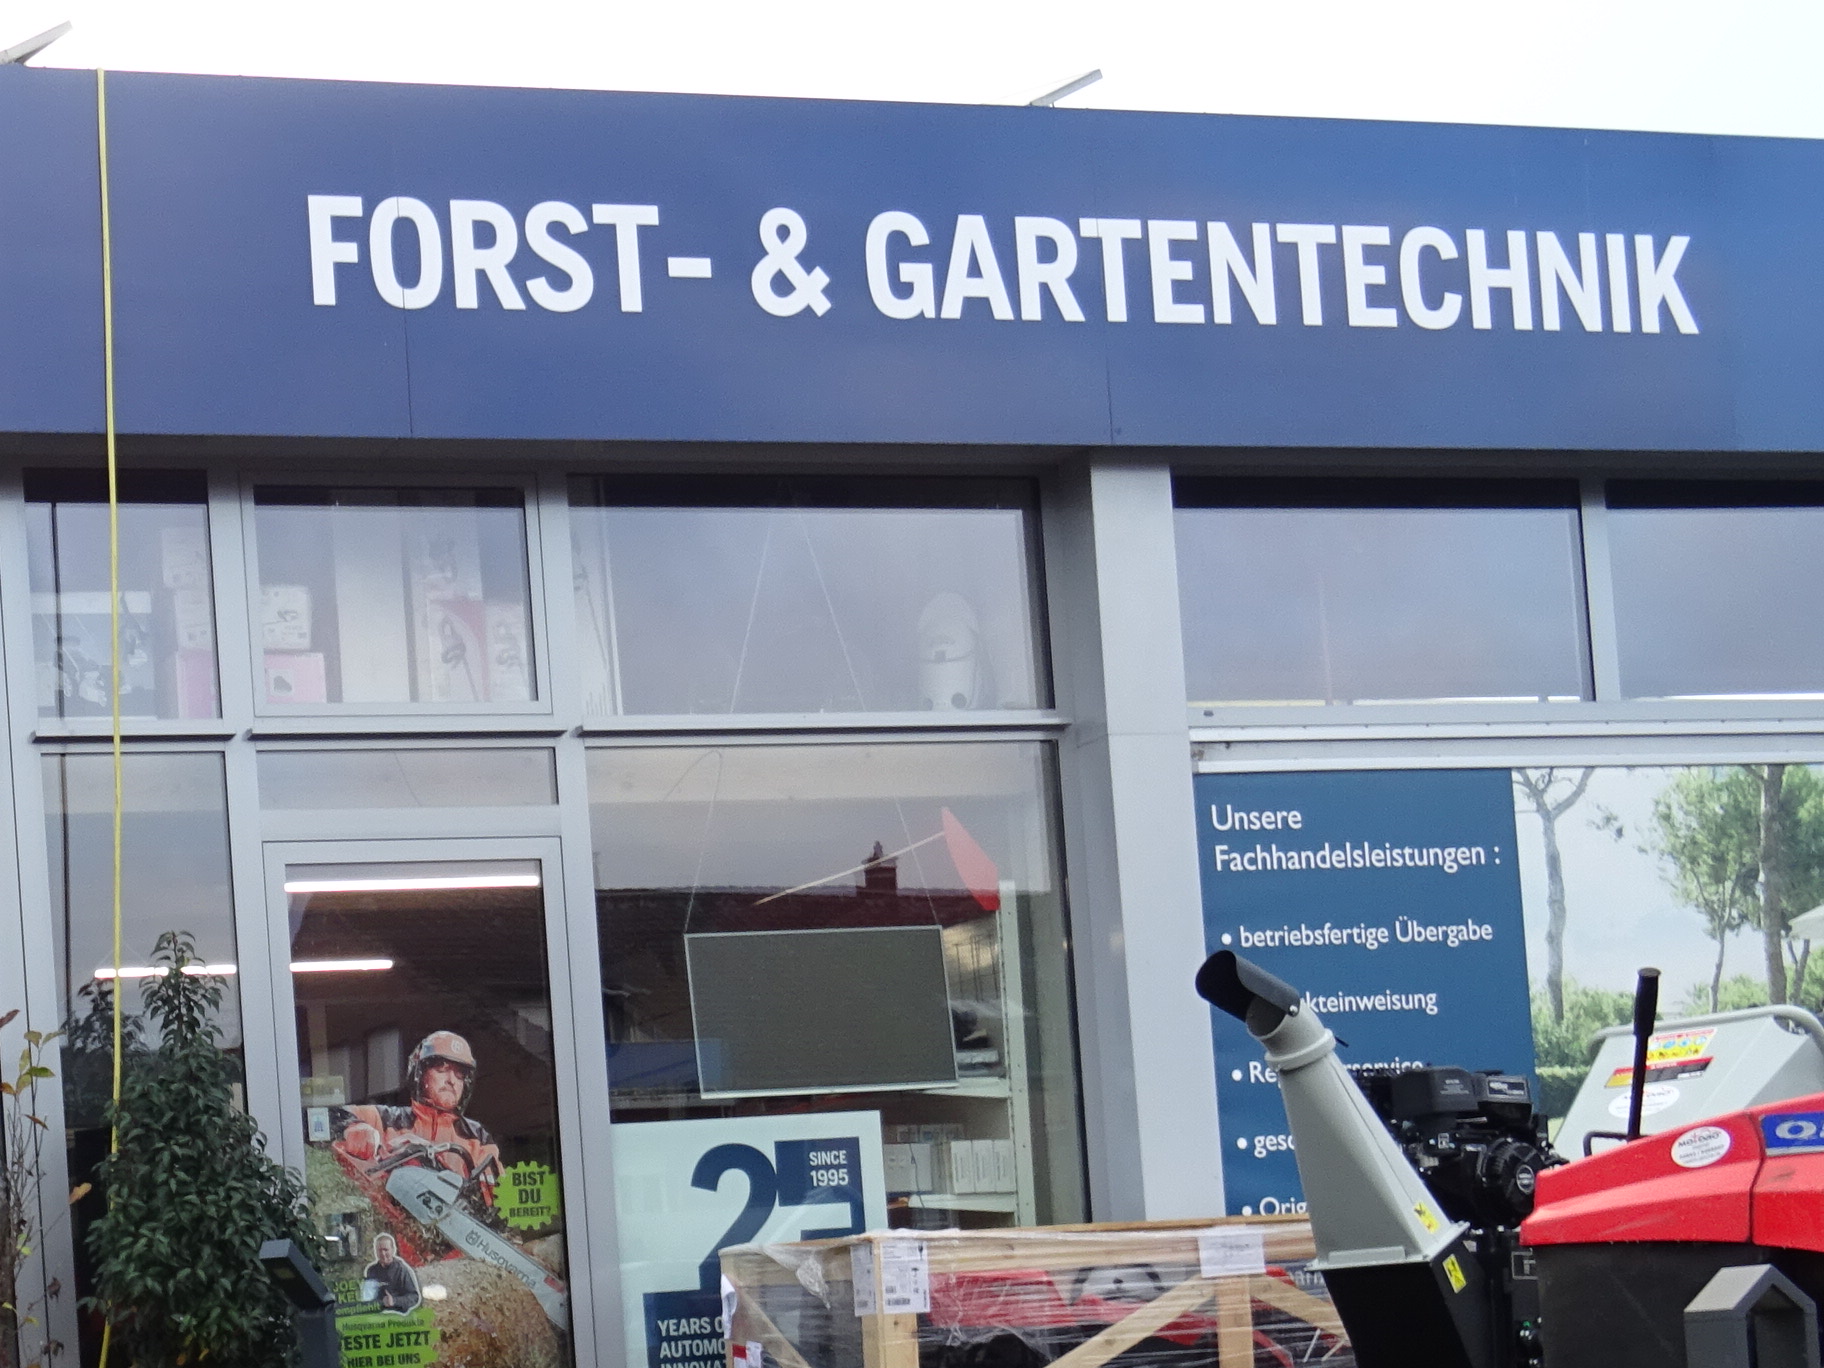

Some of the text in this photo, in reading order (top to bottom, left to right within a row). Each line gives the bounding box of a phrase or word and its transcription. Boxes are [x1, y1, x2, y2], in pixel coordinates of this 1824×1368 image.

[308, 195, 1699, 335] FORST- & GARTENTECHNIK
[1211, 804, 1302, 831] Unsere
[1214, 842, 1485, 873] Fachhandelsleistungen
[1240, 916, 1493, 949] betriebsfertige Übergabe
[809, 1150, 847, 1166] SINCE
[512, 1171, 546, 1187] BIST
[810, 1169, 848, 1187] 1995
[518, 1188, 542, 1204] DU
[509, 1206, 551, 1218] BEREIT?
[658, 1318, 711, 1337] YEARS
[343, 1331, 430, 1351] ESTE JETZT
[347, 1353, 421, 1368] HIER BEI UNS
